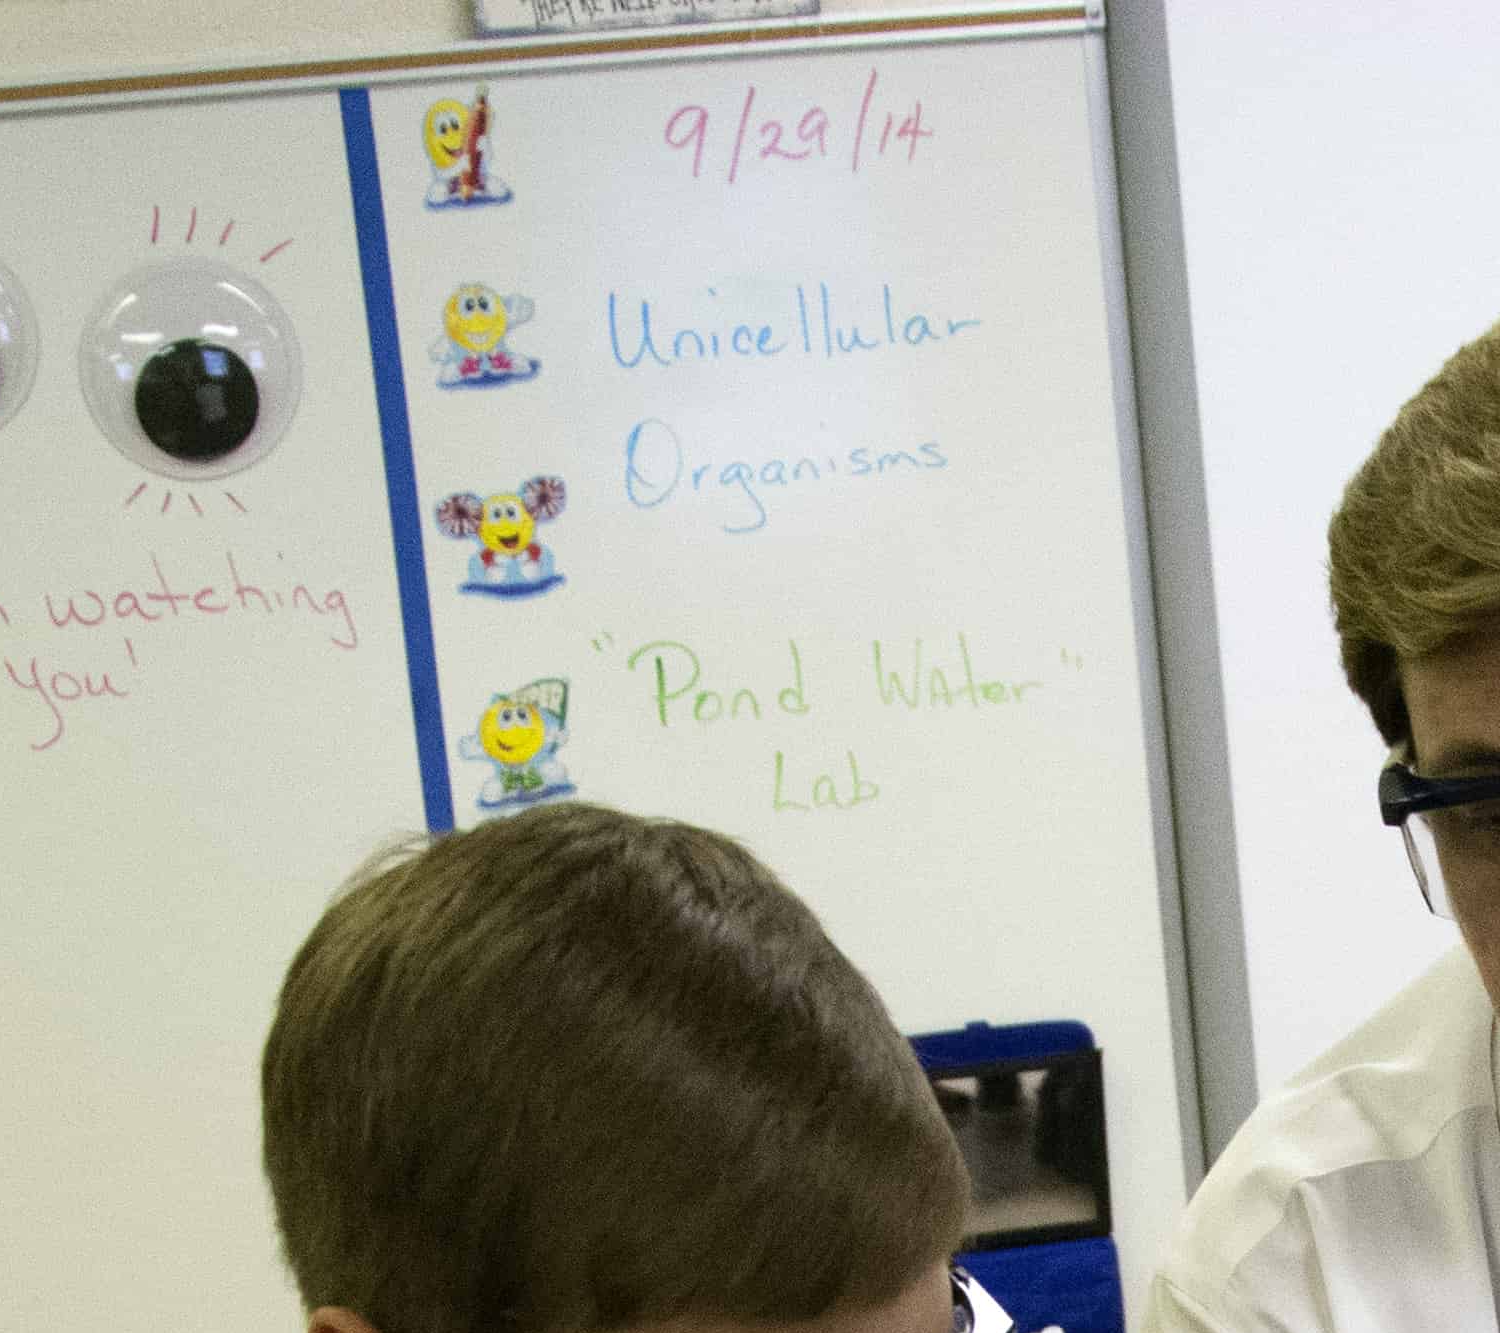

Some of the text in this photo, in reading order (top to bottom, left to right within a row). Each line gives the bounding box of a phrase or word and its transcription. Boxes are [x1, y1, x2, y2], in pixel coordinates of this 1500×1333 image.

[662, 66, 934, 185] 9/29/14
[607, 281, 984, 369] Unicellular
[622, 417, 949, 535] Organisms
[46, 552, 359, 651] watching
[772, 750, 881, 812] Lab
